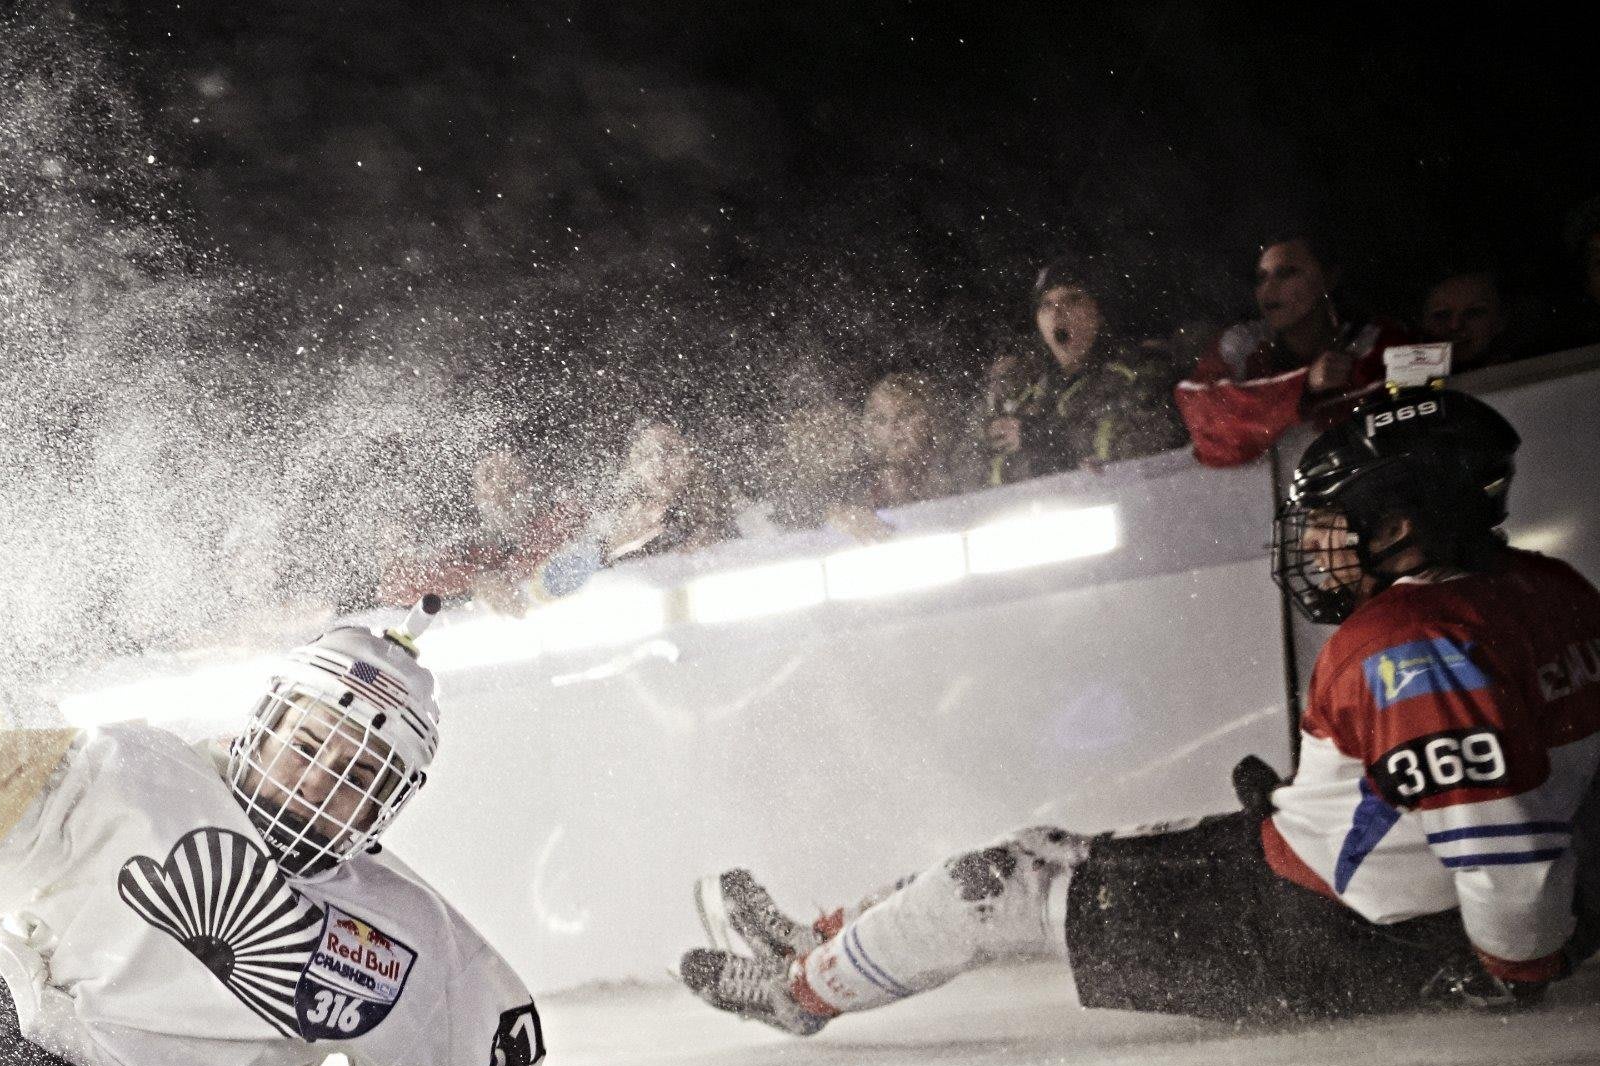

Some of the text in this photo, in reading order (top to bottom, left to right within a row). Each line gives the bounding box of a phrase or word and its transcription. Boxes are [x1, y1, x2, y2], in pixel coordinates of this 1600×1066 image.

[1374, 400, 1439, 428] 369
[1386, 731, 1507, 798] 369
[314, 952, 377, 990] CRASHED
[327, 932, 400, 981] Red Bull
[306, 989, 364, 1032] 316
